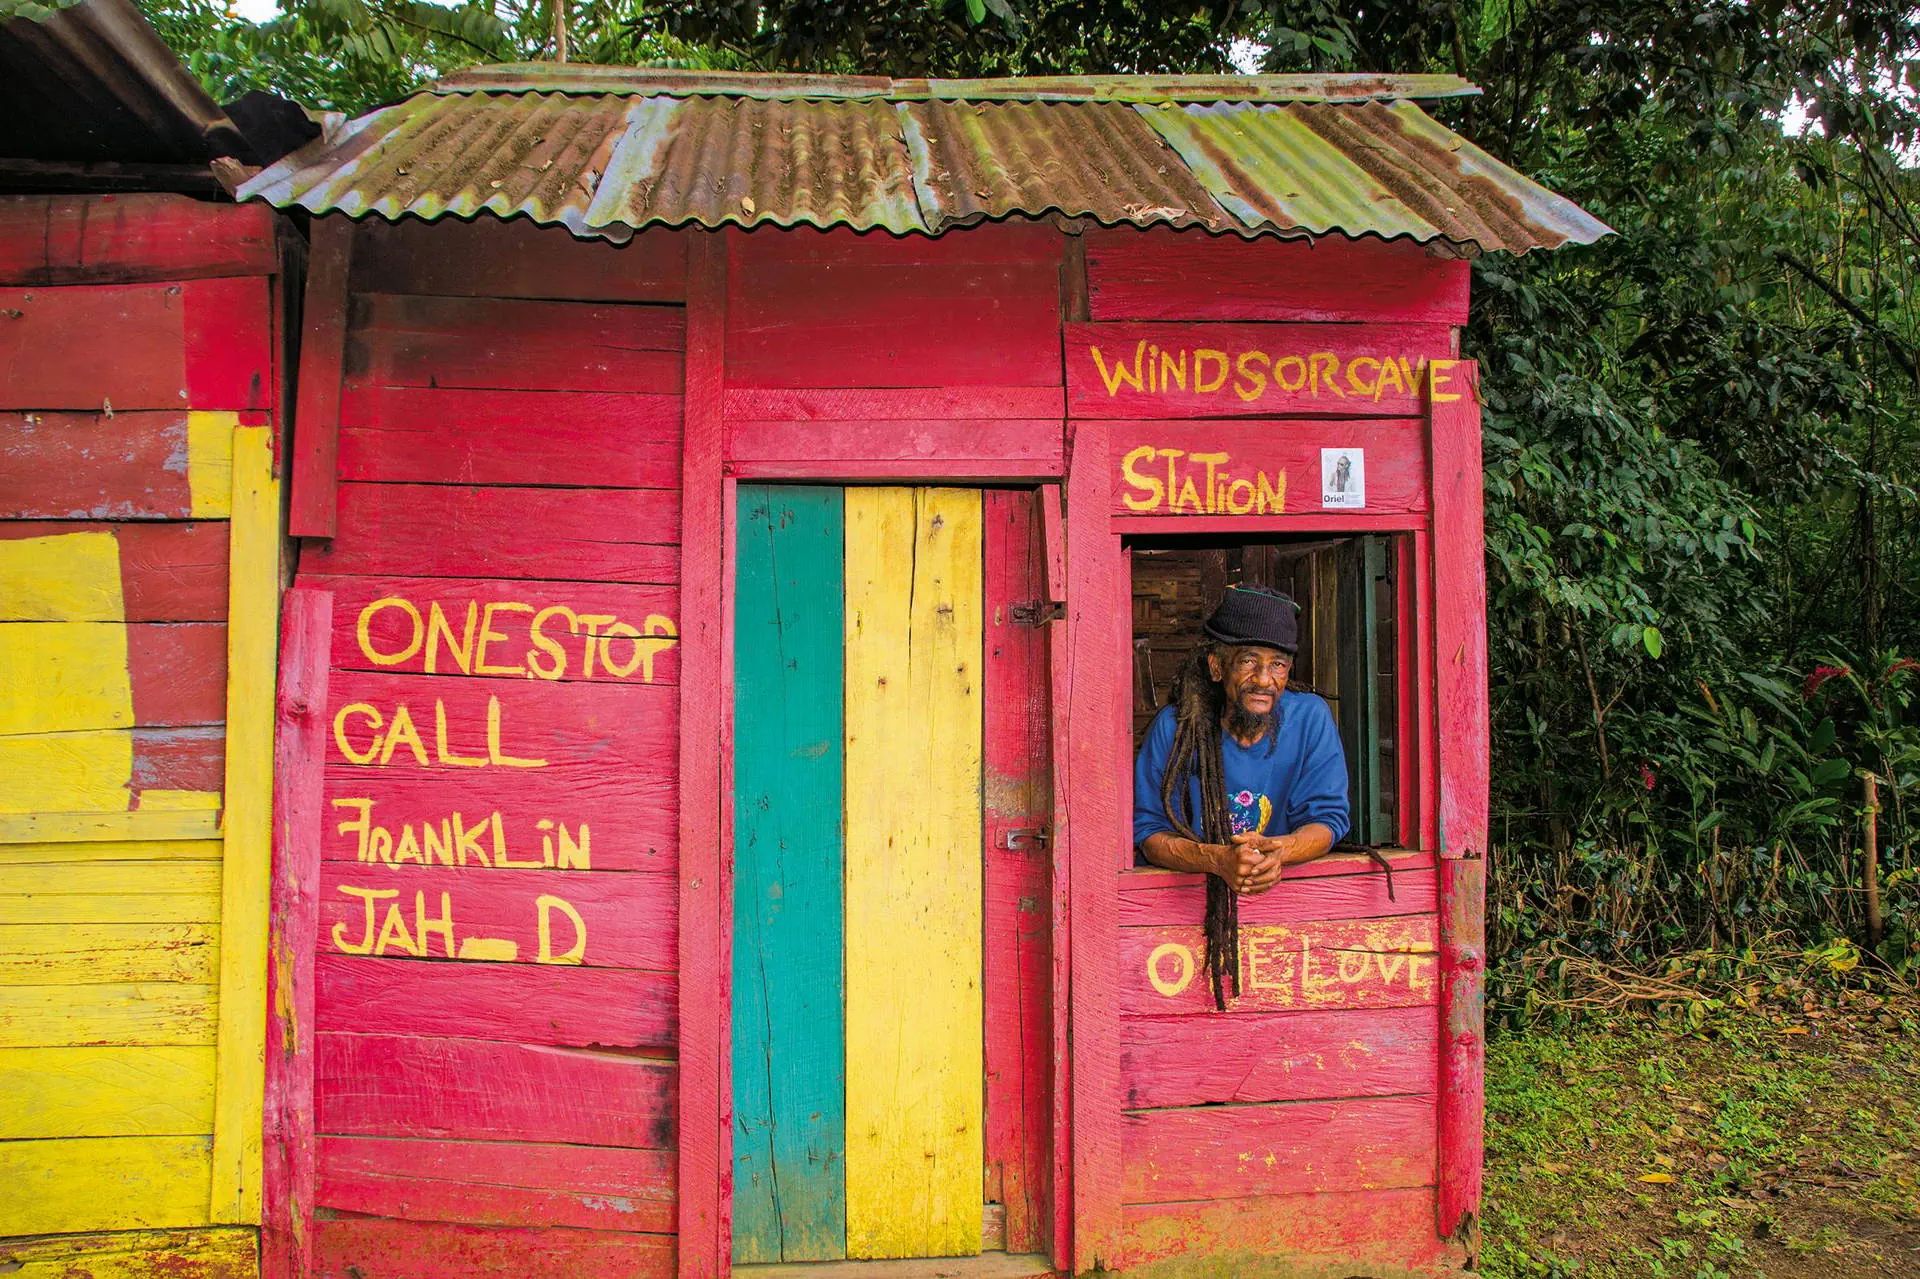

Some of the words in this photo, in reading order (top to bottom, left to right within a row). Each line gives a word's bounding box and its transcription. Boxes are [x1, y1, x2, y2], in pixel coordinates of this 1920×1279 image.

[1323, 494, 1345, 503] Oriel
[333, 695, 549, 768] CALL
[1301, 934, 1433, 990] LOVE
